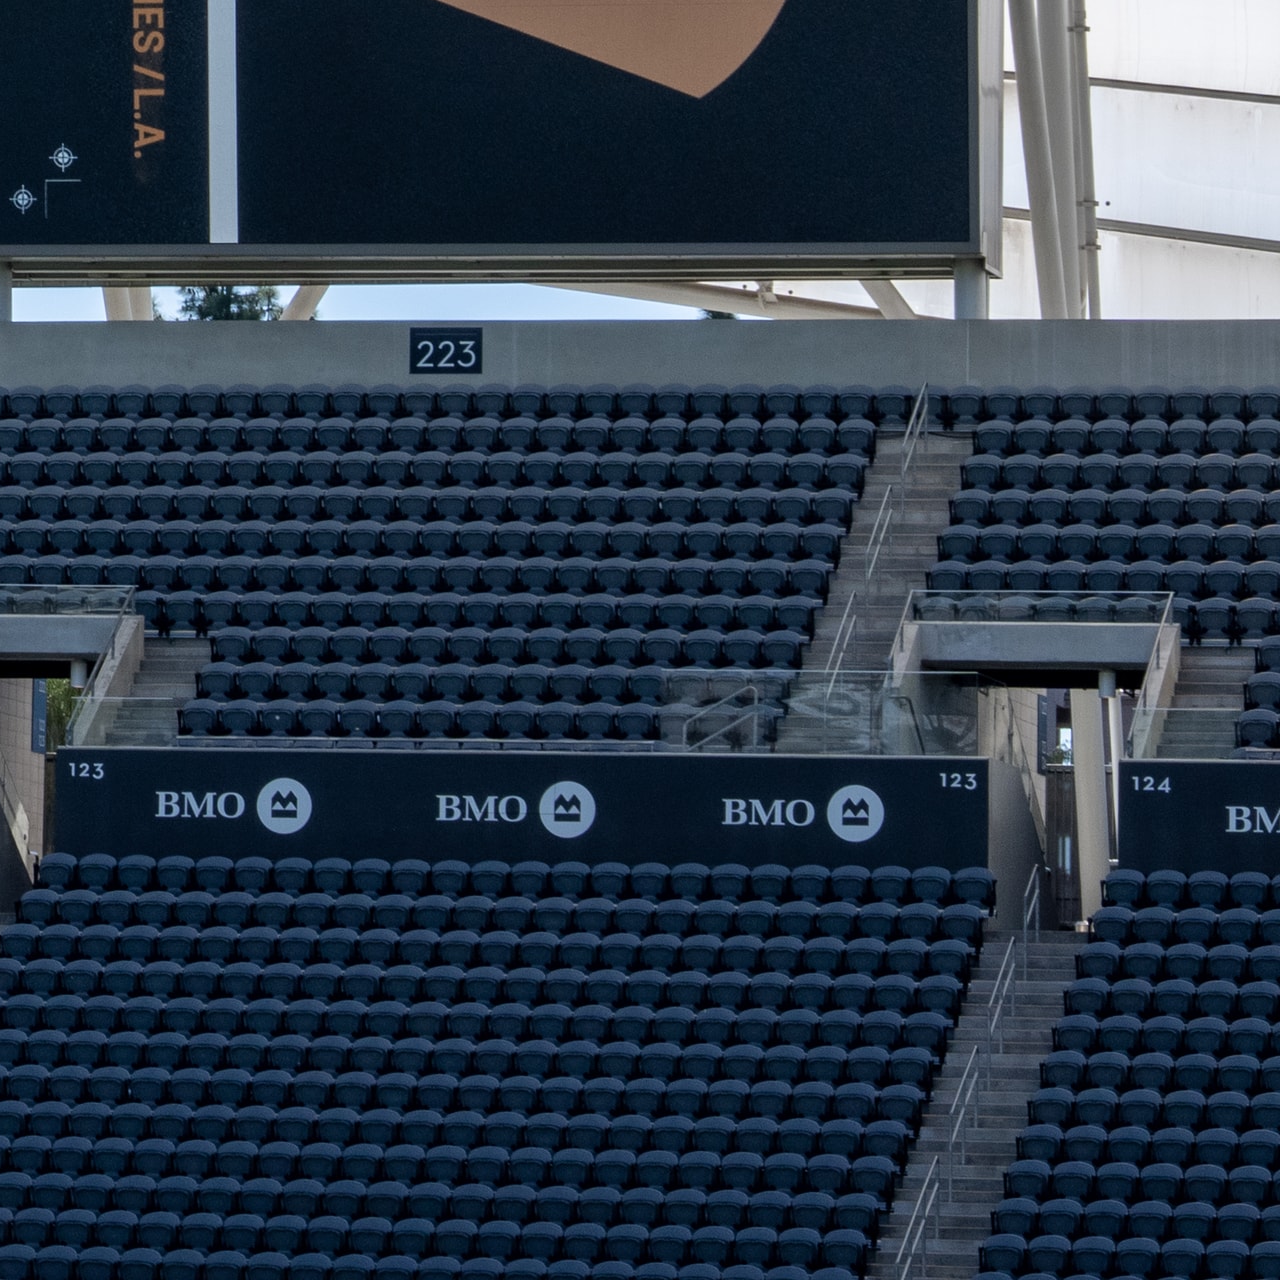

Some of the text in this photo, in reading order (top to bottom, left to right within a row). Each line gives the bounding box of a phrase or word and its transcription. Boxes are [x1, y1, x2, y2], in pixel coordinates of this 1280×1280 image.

[417, 341, 475, 367] 223
[69, 763, 104, 779] 123
[940, 773, 976, 790] 123
[1132, 776, 1171, 793] 124
[155, 792, 245, 818] BMO
[436, 795, 527, 822] BMO
[722, 799, 815, 826] BMO
[1226, 806, 1280, 833] BM
